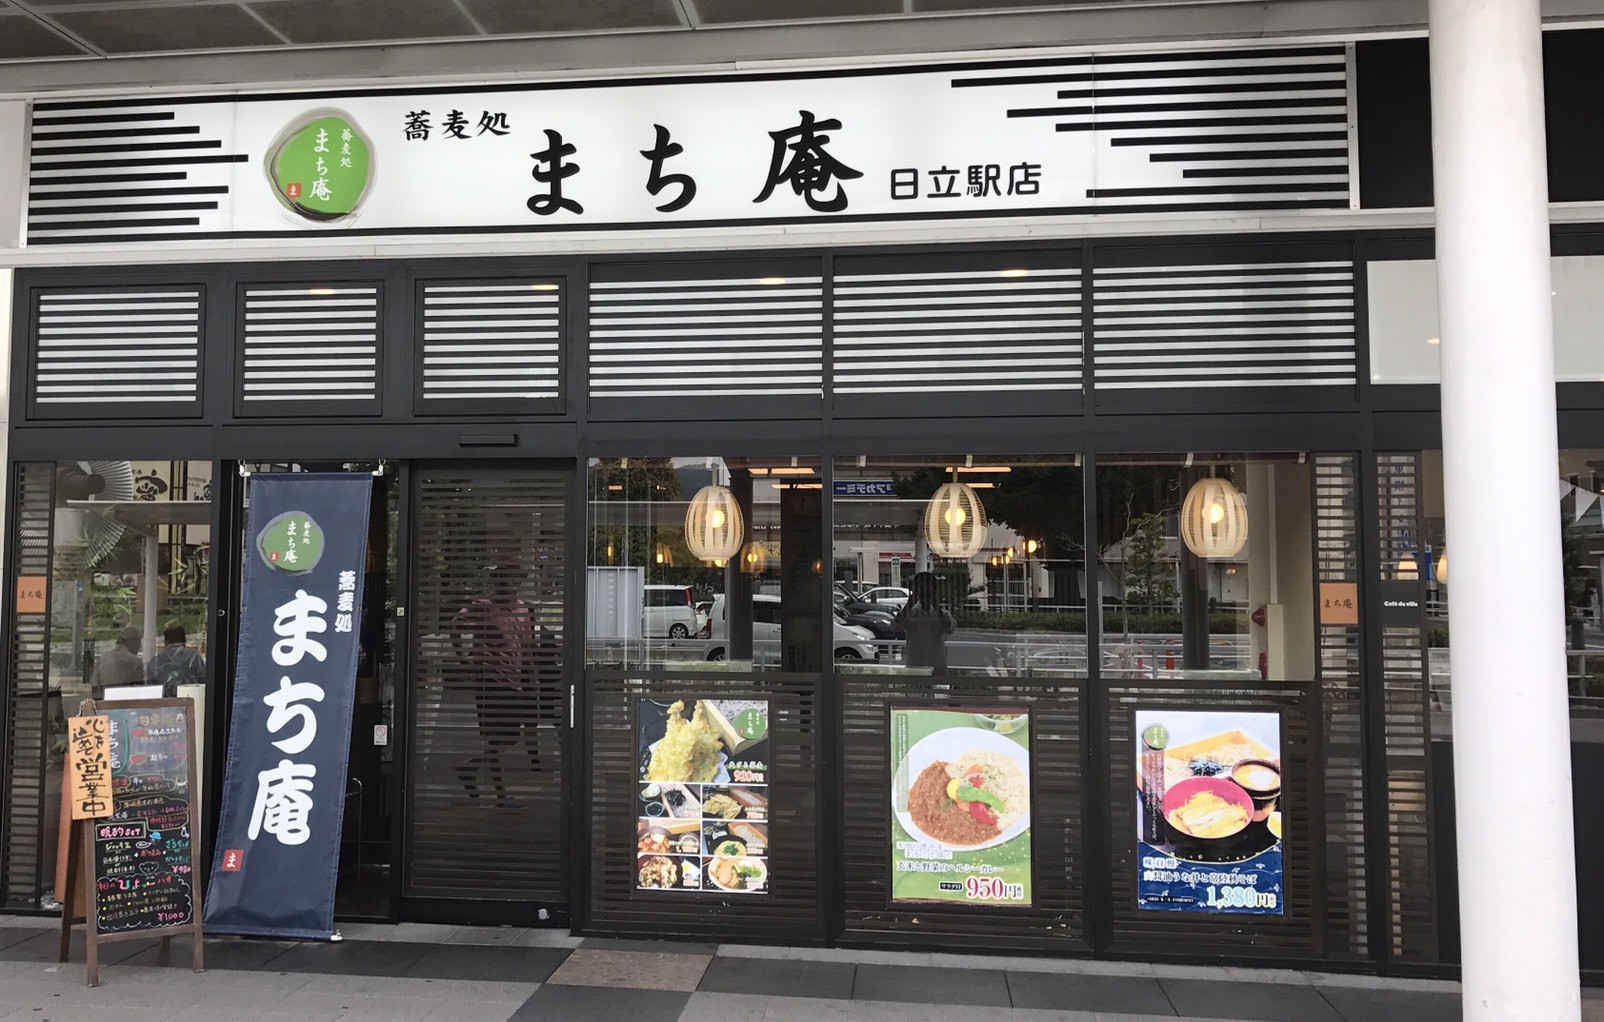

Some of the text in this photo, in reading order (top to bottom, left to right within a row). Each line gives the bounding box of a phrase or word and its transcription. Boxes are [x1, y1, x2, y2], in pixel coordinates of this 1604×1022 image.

[401, 110, 511, 141] 蕎麦処
[309, 127, 334, 202] まち庵
[340, 128, 354, 168] 蕎麦処
[526, 110, 865, 216] まち庵
[890, 162, 1042, 200] 日立駅店
[283, 520, 299, 563] まち庵
[334, 570, 356, 633] 蕎麦処
[1323, 598, 1353, 609] まち庵
[247, 588, 329, 846] まち庵
[75, 752, 110, 817] 営業中
[225, 852, 238, 869] ま
[897, 861, 1005, 873] 玄米と野菜のヘルシーカレー
